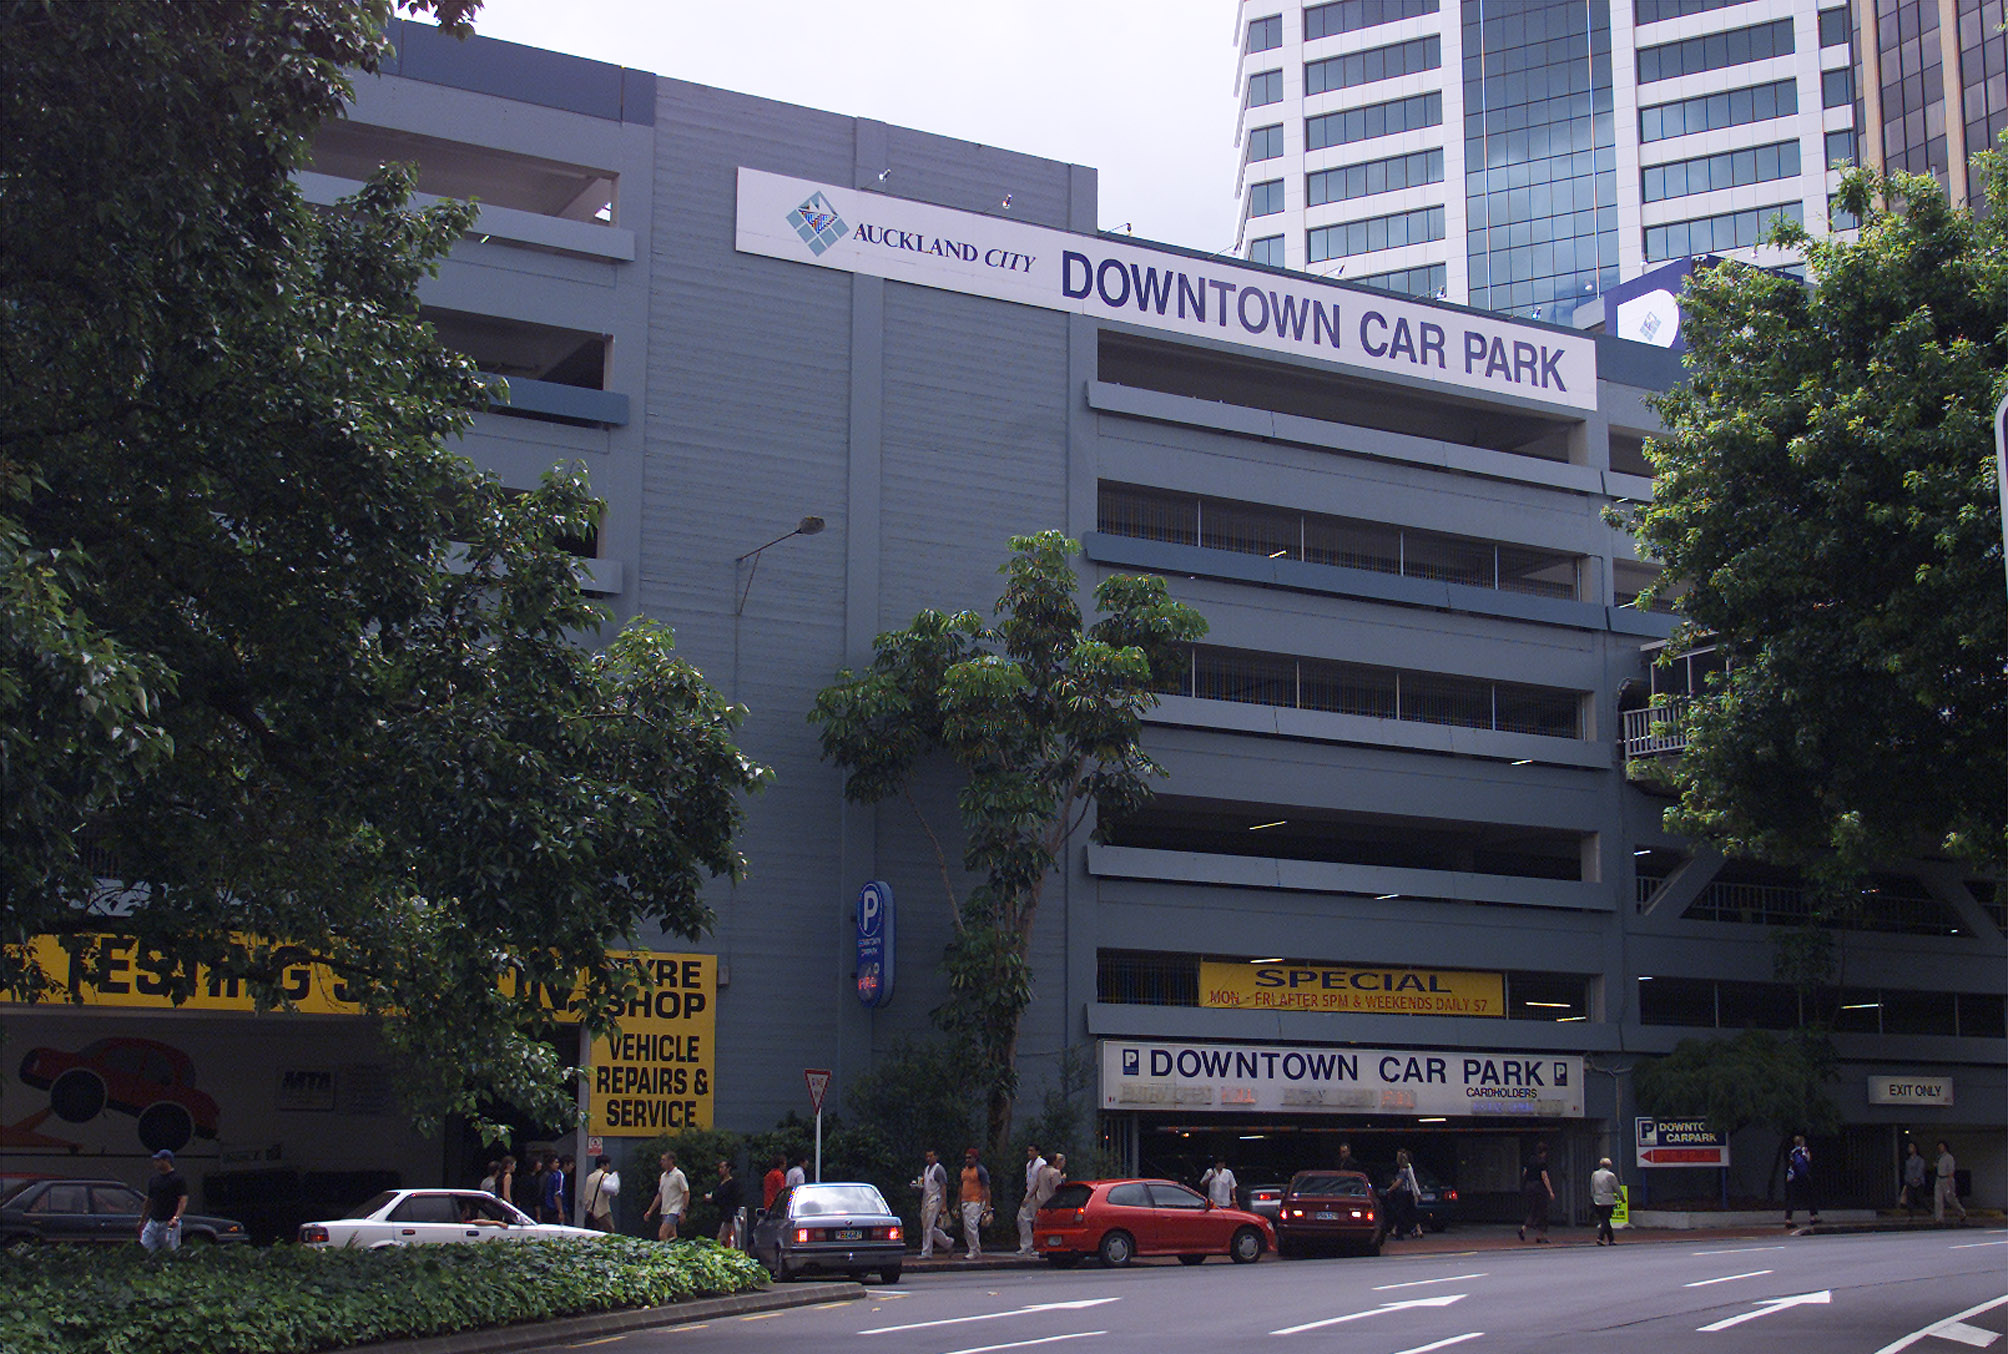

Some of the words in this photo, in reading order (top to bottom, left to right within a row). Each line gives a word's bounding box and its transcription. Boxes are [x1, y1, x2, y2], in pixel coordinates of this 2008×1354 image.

[853, 223, 978, 262] AUCKLAND
[985, 248, 1036, 273] CITY
[1062, 250, 1340, 348] DOWNTOWN
[1360, 311, 1446, 370] CAR
[1464, 330, 1567, 392] PARK
[864, 889, 879, 931] P
[1255, 969, 1452, 993] SPECIAL
[1210, 989, 1240, 1005] MON
[1279, 992, 1318, 1007] AFTER
[1365, 995, 1432, 1010] WEEKENDS
[1436, 998, 1470, 1012] DAILY
[609, 1033, 700, 1063] VEHICLE
[597, 1066, 688, 1095] REPAIRS
[694, 1068, 708, 1095] &
[1151, 1049, 1358, 1081] DOWNTOWN
[1379, 1056, 1447, 1084] CAR
[1463, 1059, 1544, 1087] PARK
[1466, 1087, 1537, 1098] CARDHOLDERS
[1889, 1084, 1912, 1096] EXIT
[1915, 1084, 1941, 1097] ONLY
[606, 1099, 696, 1127] SERVICE
[1666, 1132, 1717, 1143] CARPARK
